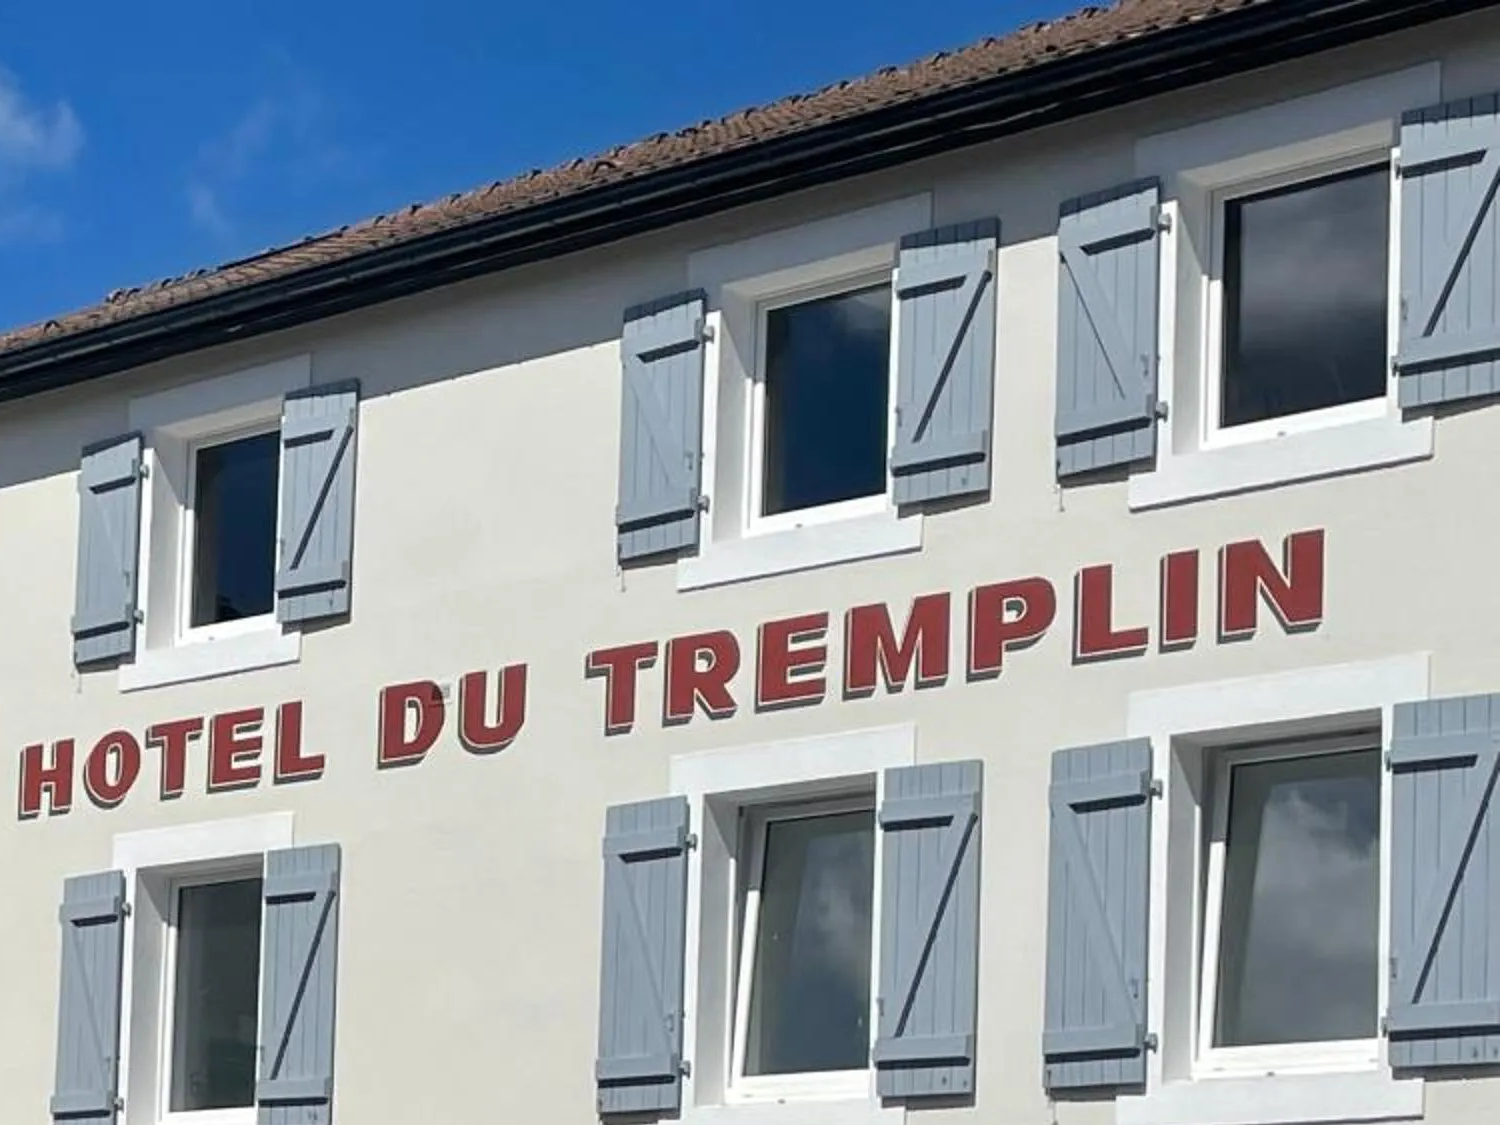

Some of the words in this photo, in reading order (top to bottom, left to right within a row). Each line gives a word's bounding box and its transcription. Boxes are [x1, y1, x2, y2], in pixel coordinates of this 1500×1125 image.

[18, 701, 325, 820] HOTEL
[377, 663, 527, 769] DU
[585, 528, 1325, 736] TREMPLIN
